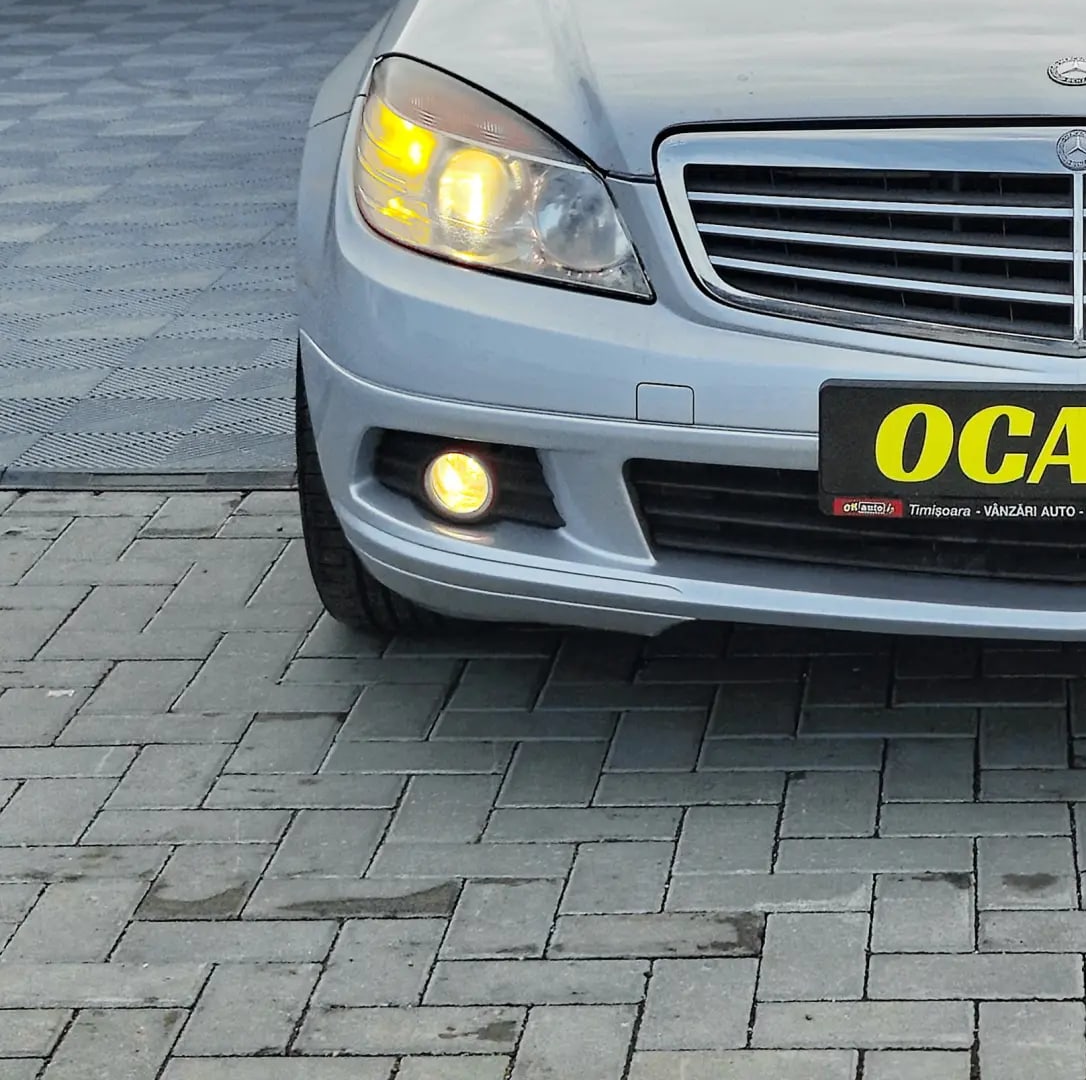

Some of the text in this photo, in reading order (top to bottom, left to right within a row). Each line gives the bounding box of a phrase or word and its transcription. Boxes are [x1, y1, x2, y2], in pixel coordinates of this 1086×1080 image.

[909, 503, 971, 518] Timișoara
[983, 503, 1037, 517] VÂNZĂRI
[1041, 506, 1076, 517] AUTO
